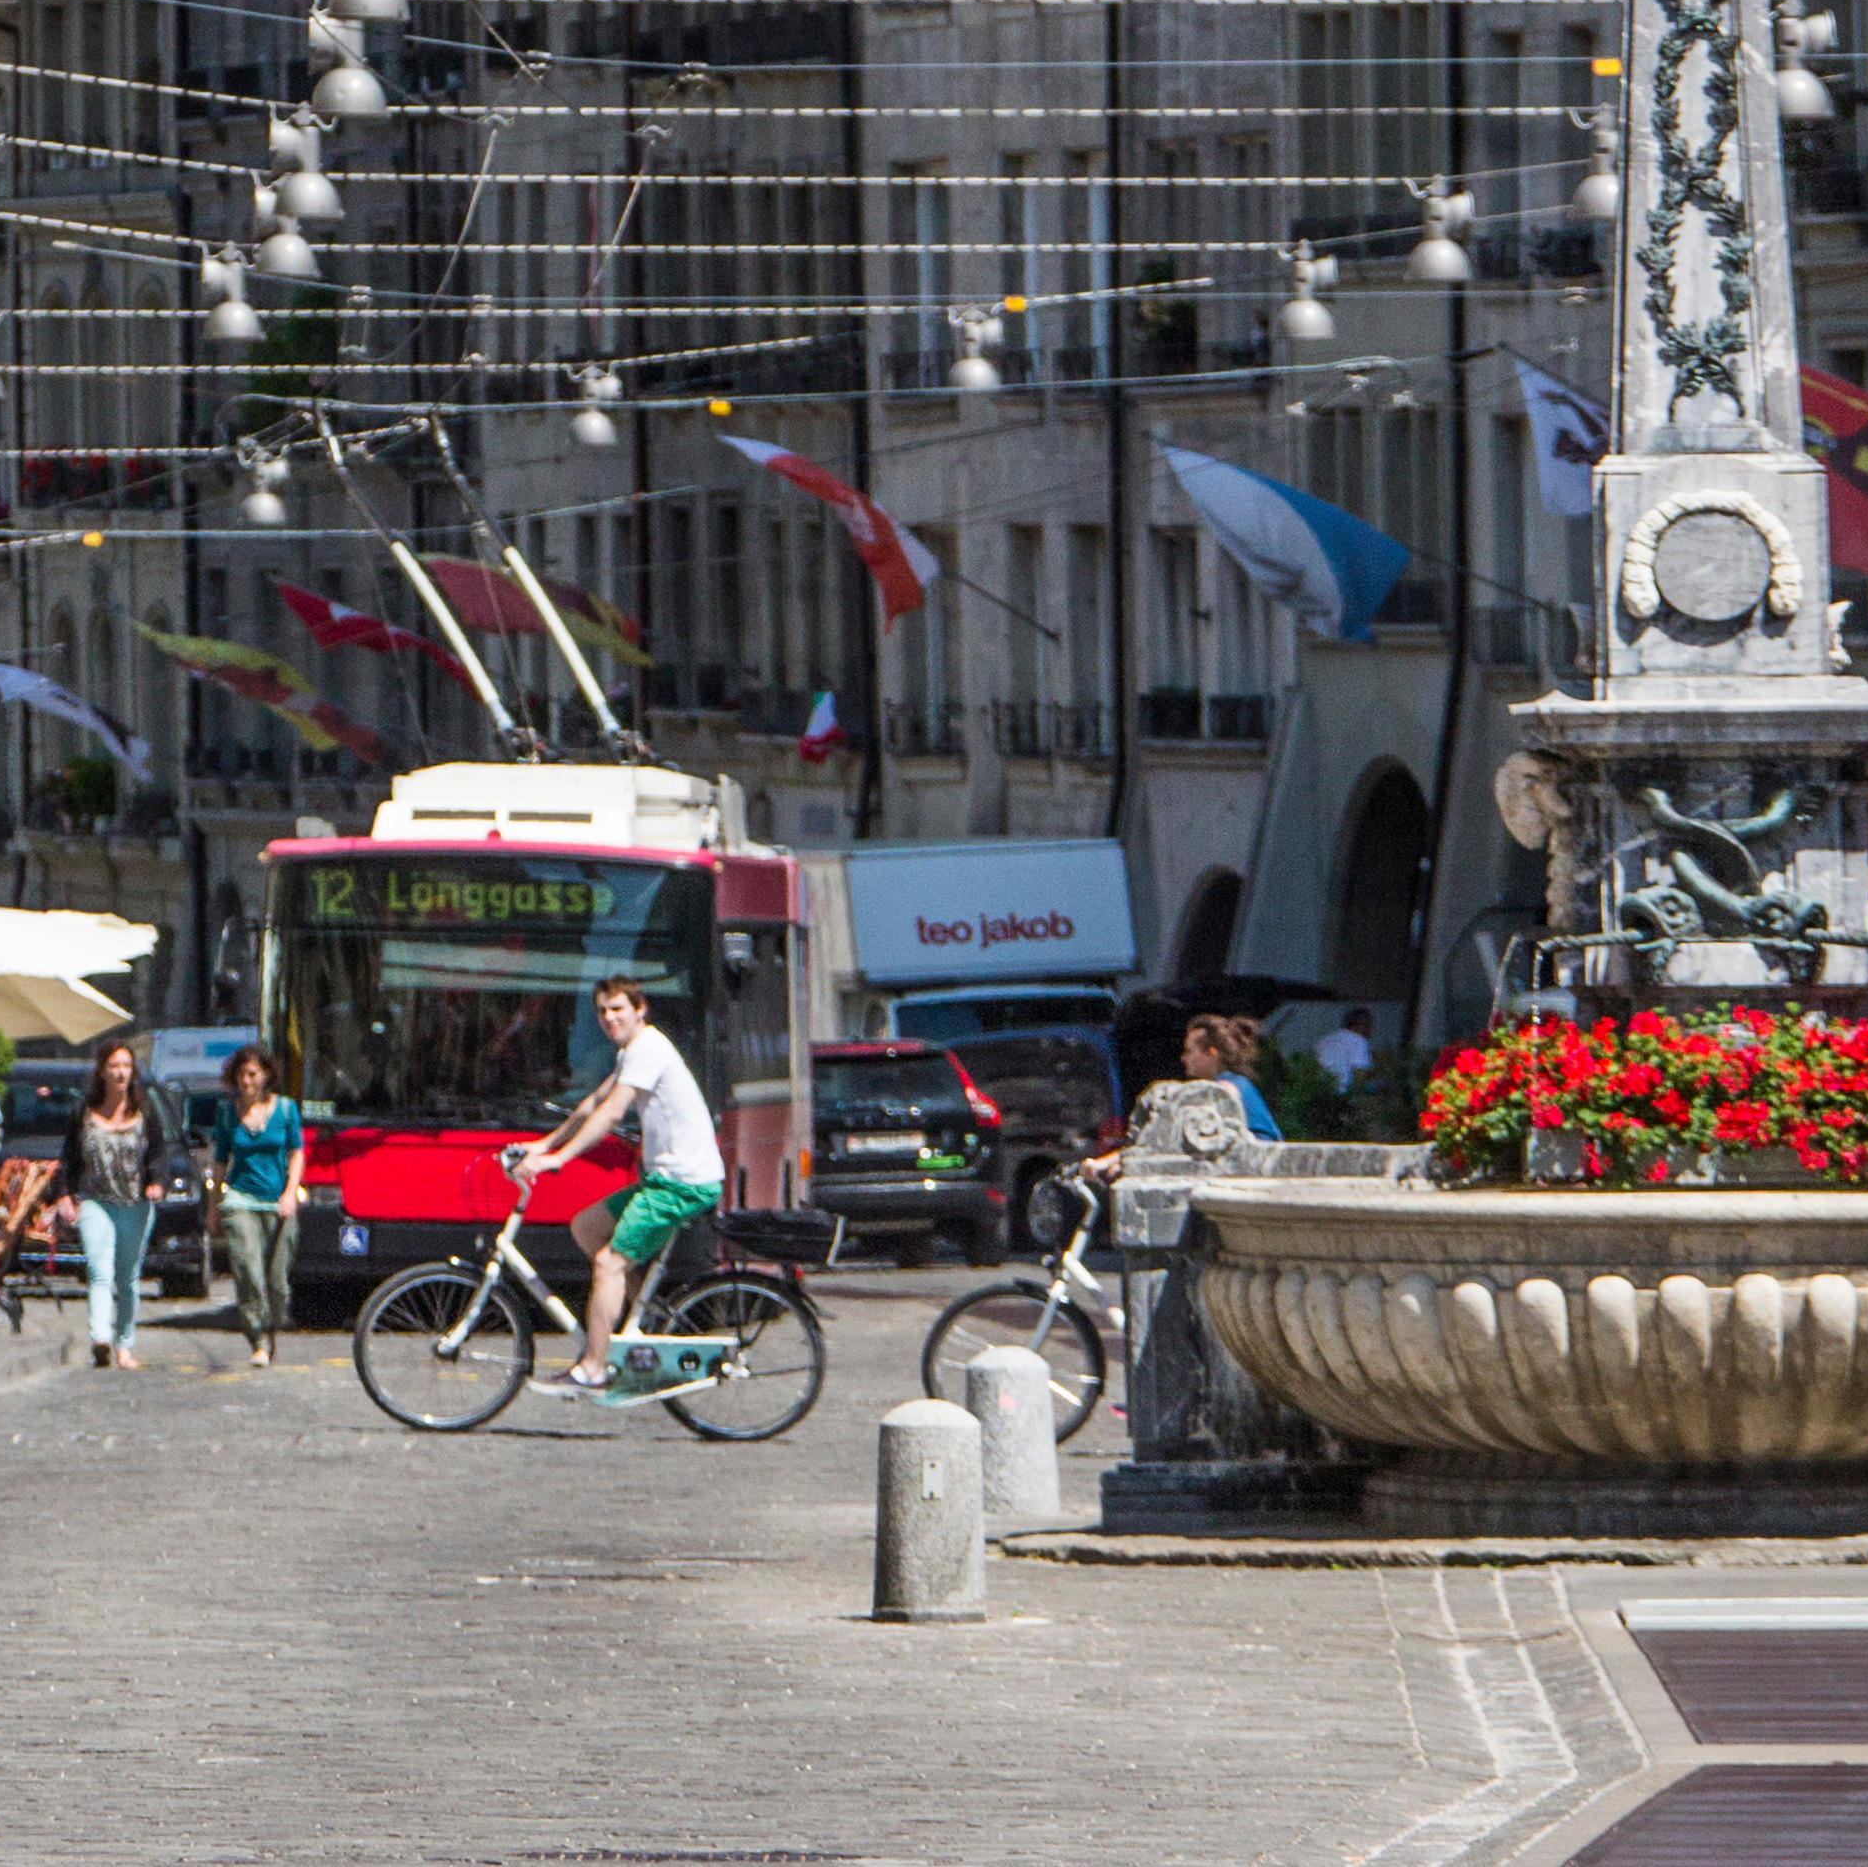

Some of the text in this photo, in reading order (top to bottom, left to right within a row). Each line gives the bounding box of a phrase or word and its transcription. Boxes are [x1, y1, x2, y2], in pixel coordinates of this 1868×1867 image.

[311, 869, 354, 916] 12
[917, 909, 1075, 950] teo jakob
